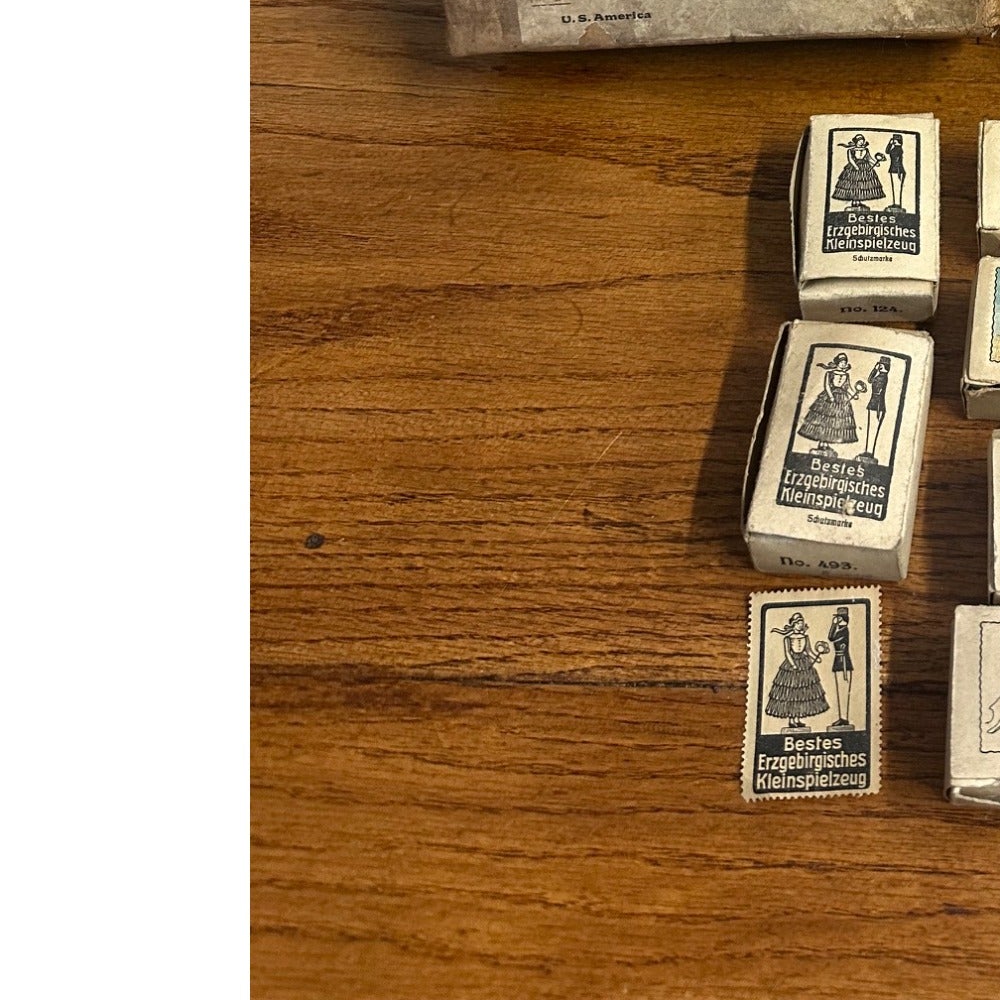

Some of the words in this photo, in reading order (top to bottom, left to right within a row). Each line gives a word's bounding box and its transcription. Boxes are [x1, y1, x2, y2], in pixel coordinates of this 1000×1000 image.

[594, 12, 651, 22] America
[848, 212, 897, 224] Bestes
[826, 223, 917, 241] Erzgebirgisches
[825, 237, 917, 253] Kleinspielzeug
[852, 254, 893, 263] Schutzmarke
[811, 458, 866, 477] Bestes
[784, 471, 886, 499] Erzgebirgisches
[780, 487, 883, 518] Kleinspielzeug
[807, 515, 853, 528] Schutzmarke
[784, 736, 842, 751] Bestes
[758, 751, 867, 773] Erzgebirgisches
[756, 770, 867, 790] Kleinspielzeug
